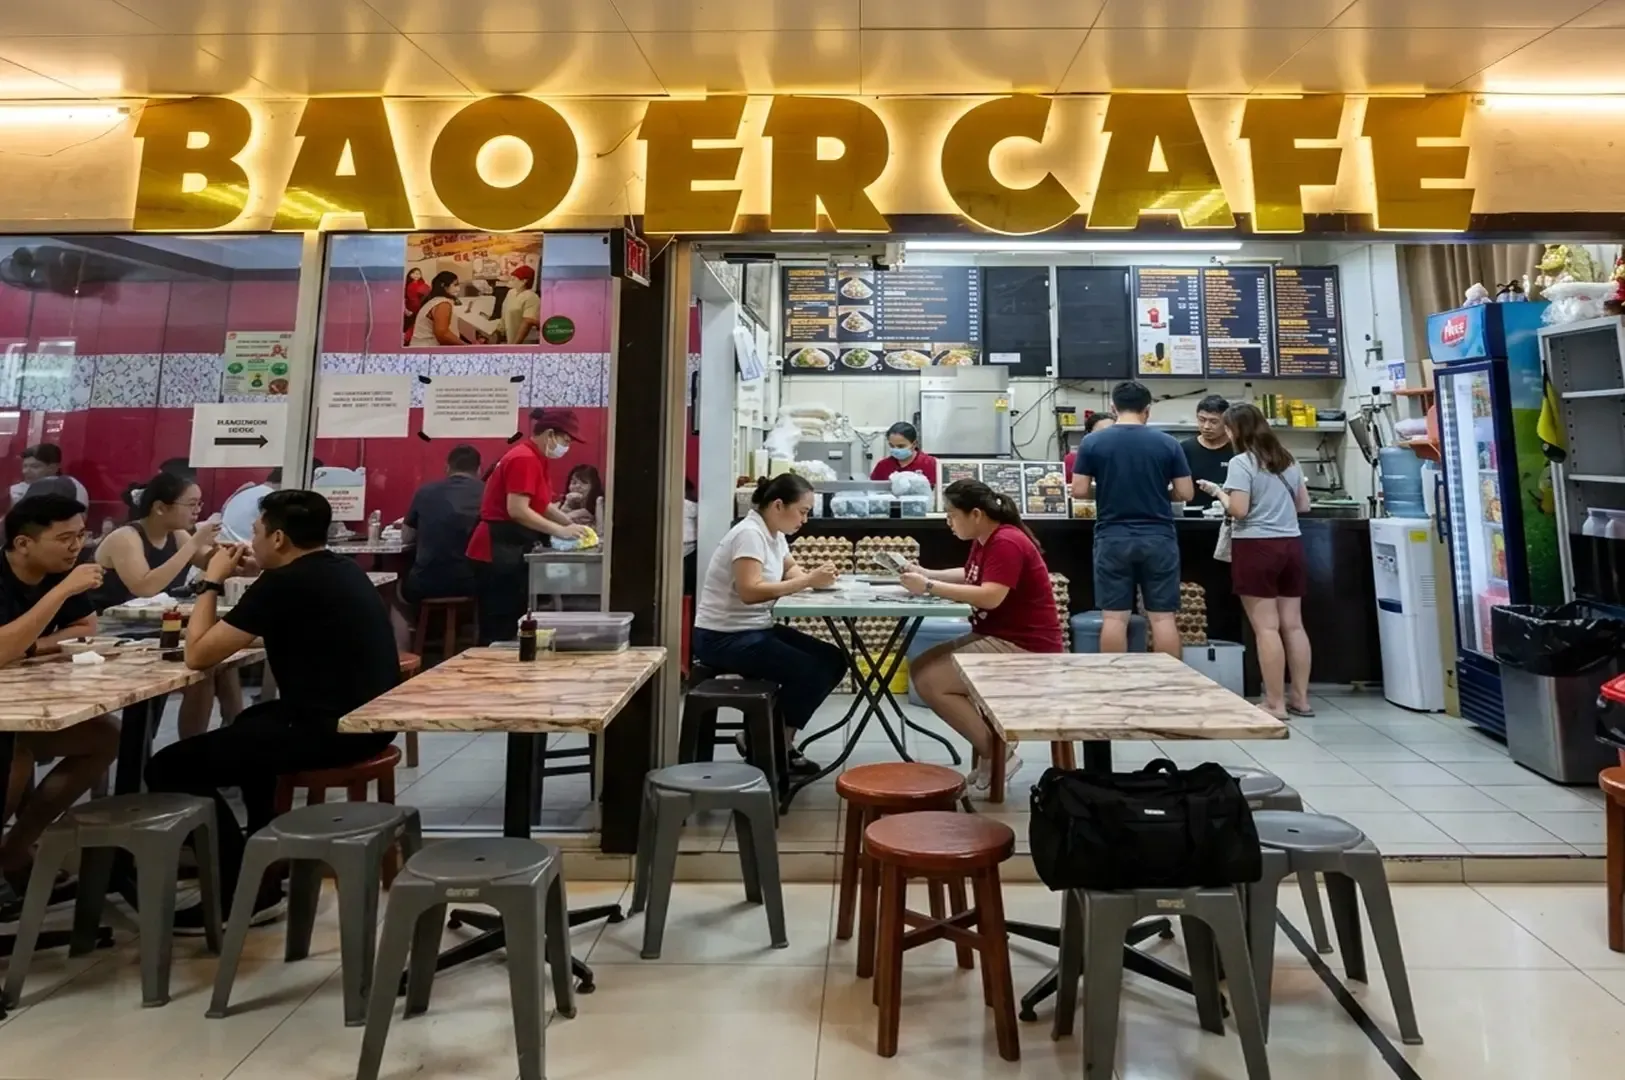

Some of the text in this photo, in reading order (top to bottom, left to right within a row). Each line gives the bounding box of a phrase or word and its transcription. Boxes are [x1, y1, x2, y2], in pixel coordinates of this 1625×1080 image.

[133, 94, 1476, 234] BAO ER CAFE
